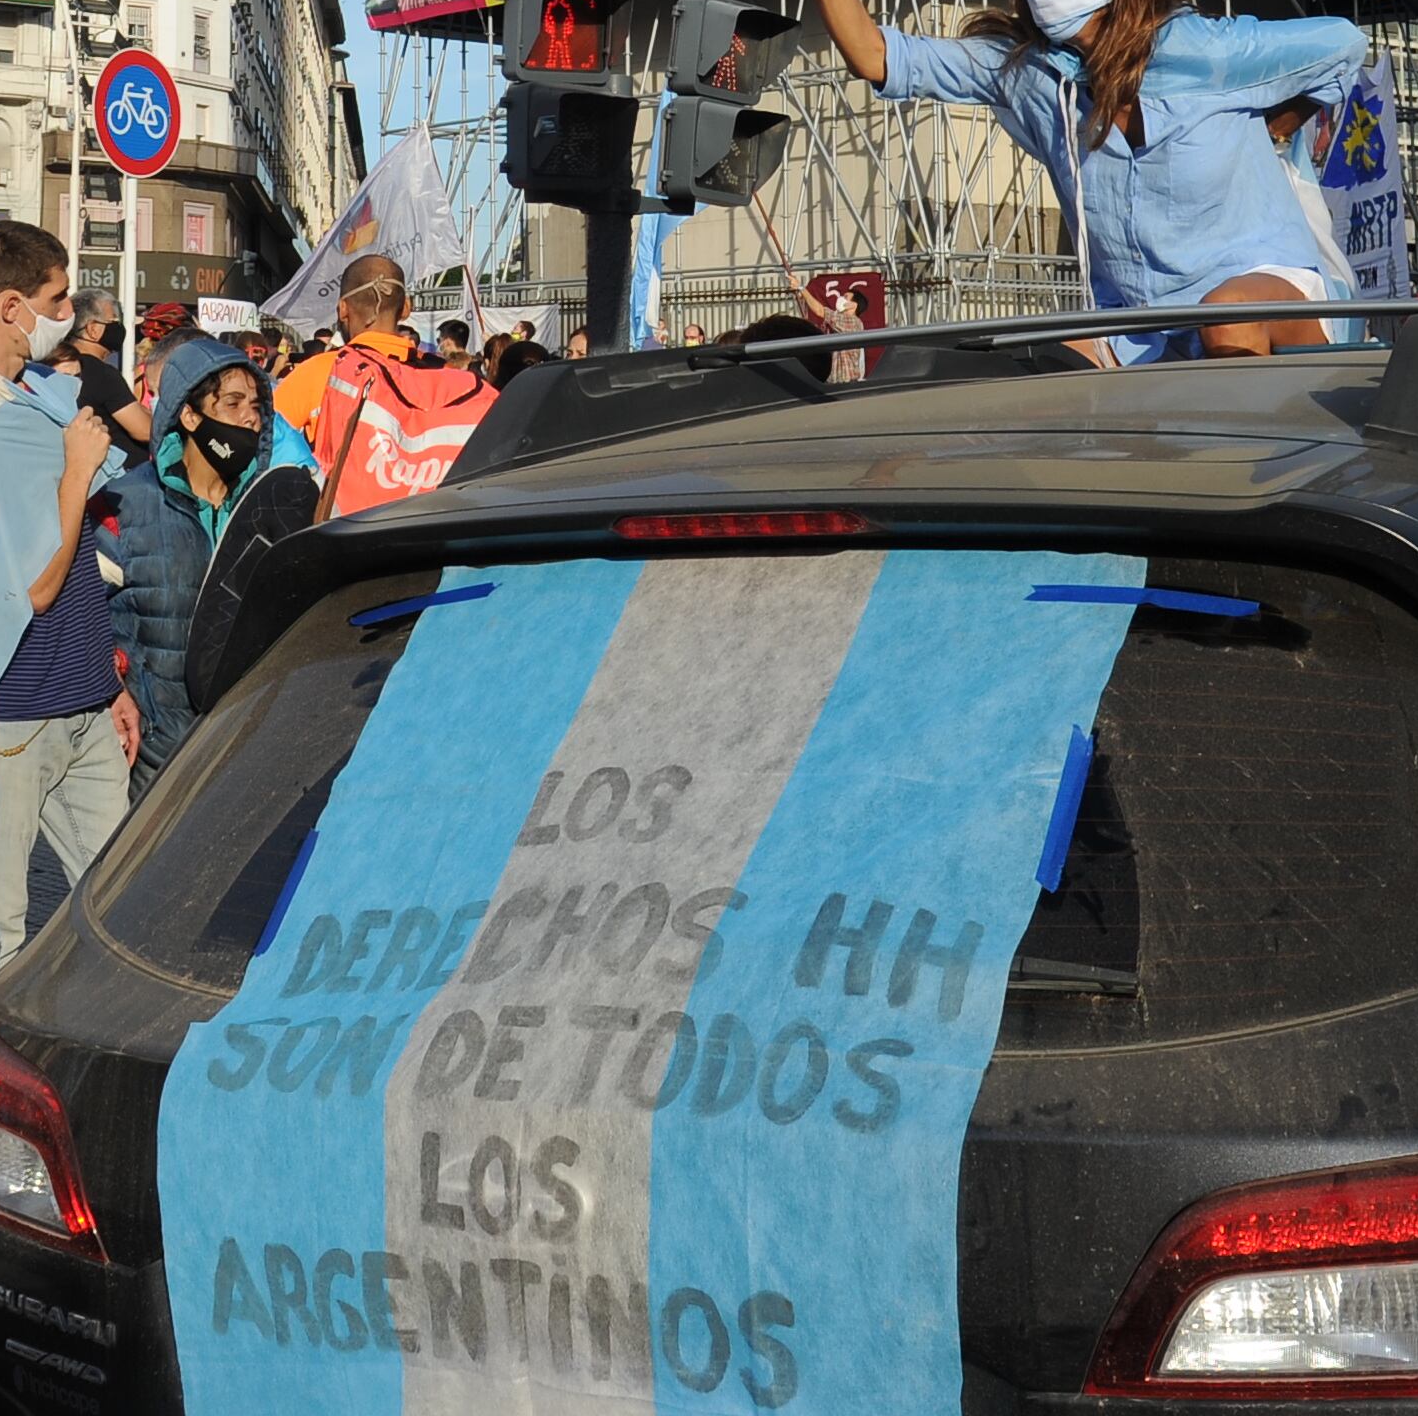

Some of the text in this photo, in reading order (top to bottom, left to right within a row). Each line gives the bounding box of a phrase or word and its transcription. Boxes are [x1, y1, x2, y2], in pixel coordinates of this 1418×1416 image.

[201, 302, 238, 325] ABRAN
[517, 764, 692, 848] LOS
[279, 881, 985, 1023] DERECHOS HH
[206, 1005, 914, 1134] SON DE TODOS
[420, 1131, 589, 1245] LOS
[211, 1237, 800, 1411] ARGENTINOS
